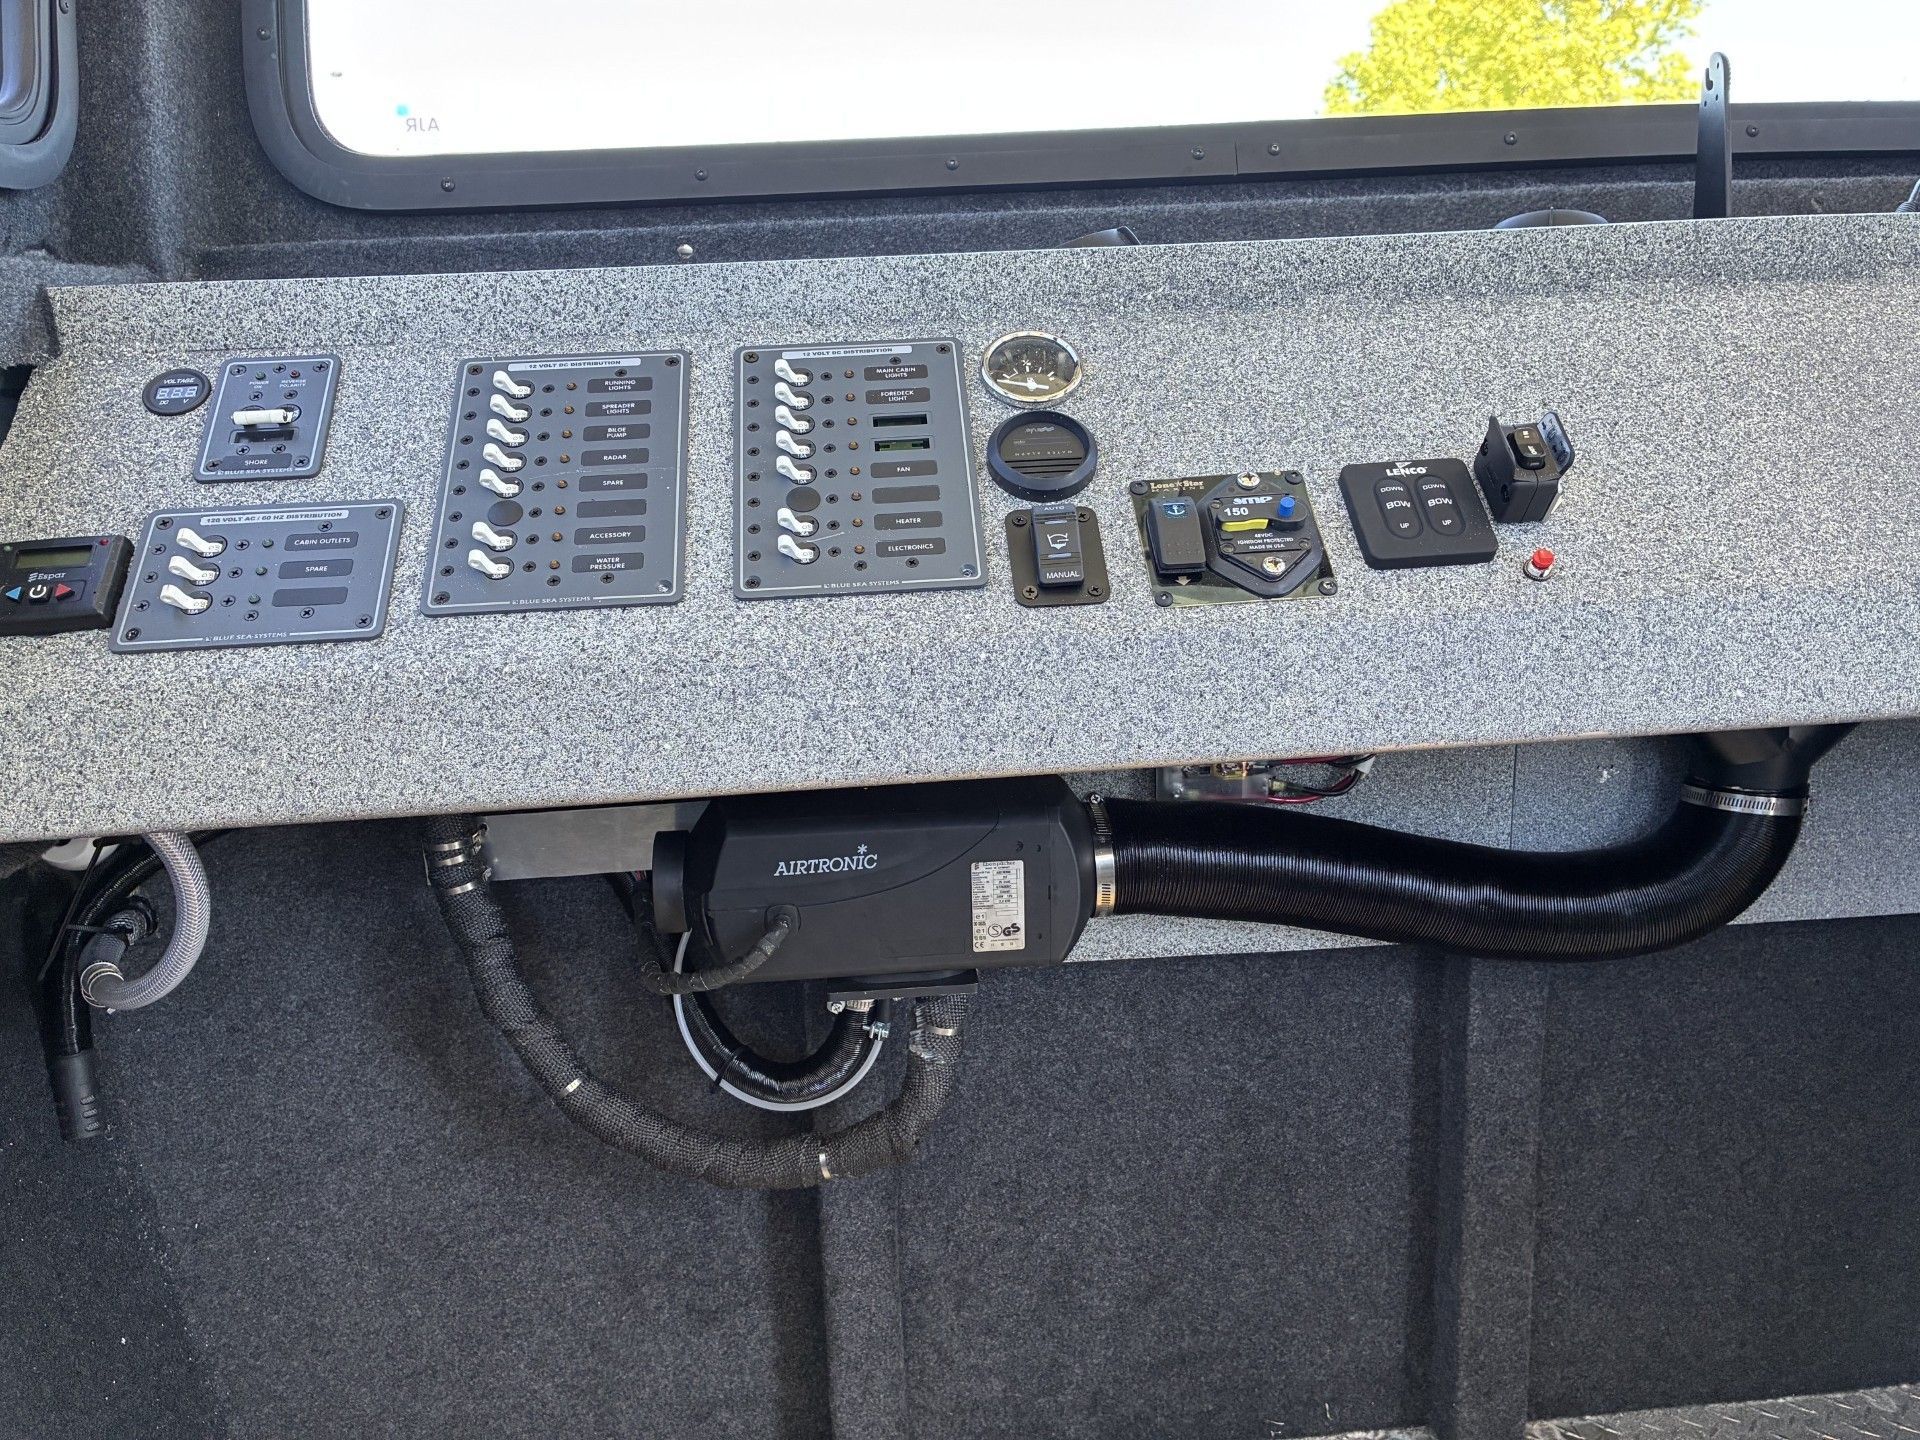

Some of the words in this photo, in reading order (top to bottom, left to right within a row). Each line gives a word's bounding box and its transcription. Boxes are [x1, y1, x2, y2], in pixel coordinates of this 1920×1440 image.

[1386, 466, 1427, 477] LENCO
[1386, 500, 1410, 509] BOW
[1428, 498, 1452, 506] BOW
[1224, 507, 1248, 516] 150
[1046, 571, 1080, 579] MANUAL
[774, 854, 877, 876] AIRTRONIC
